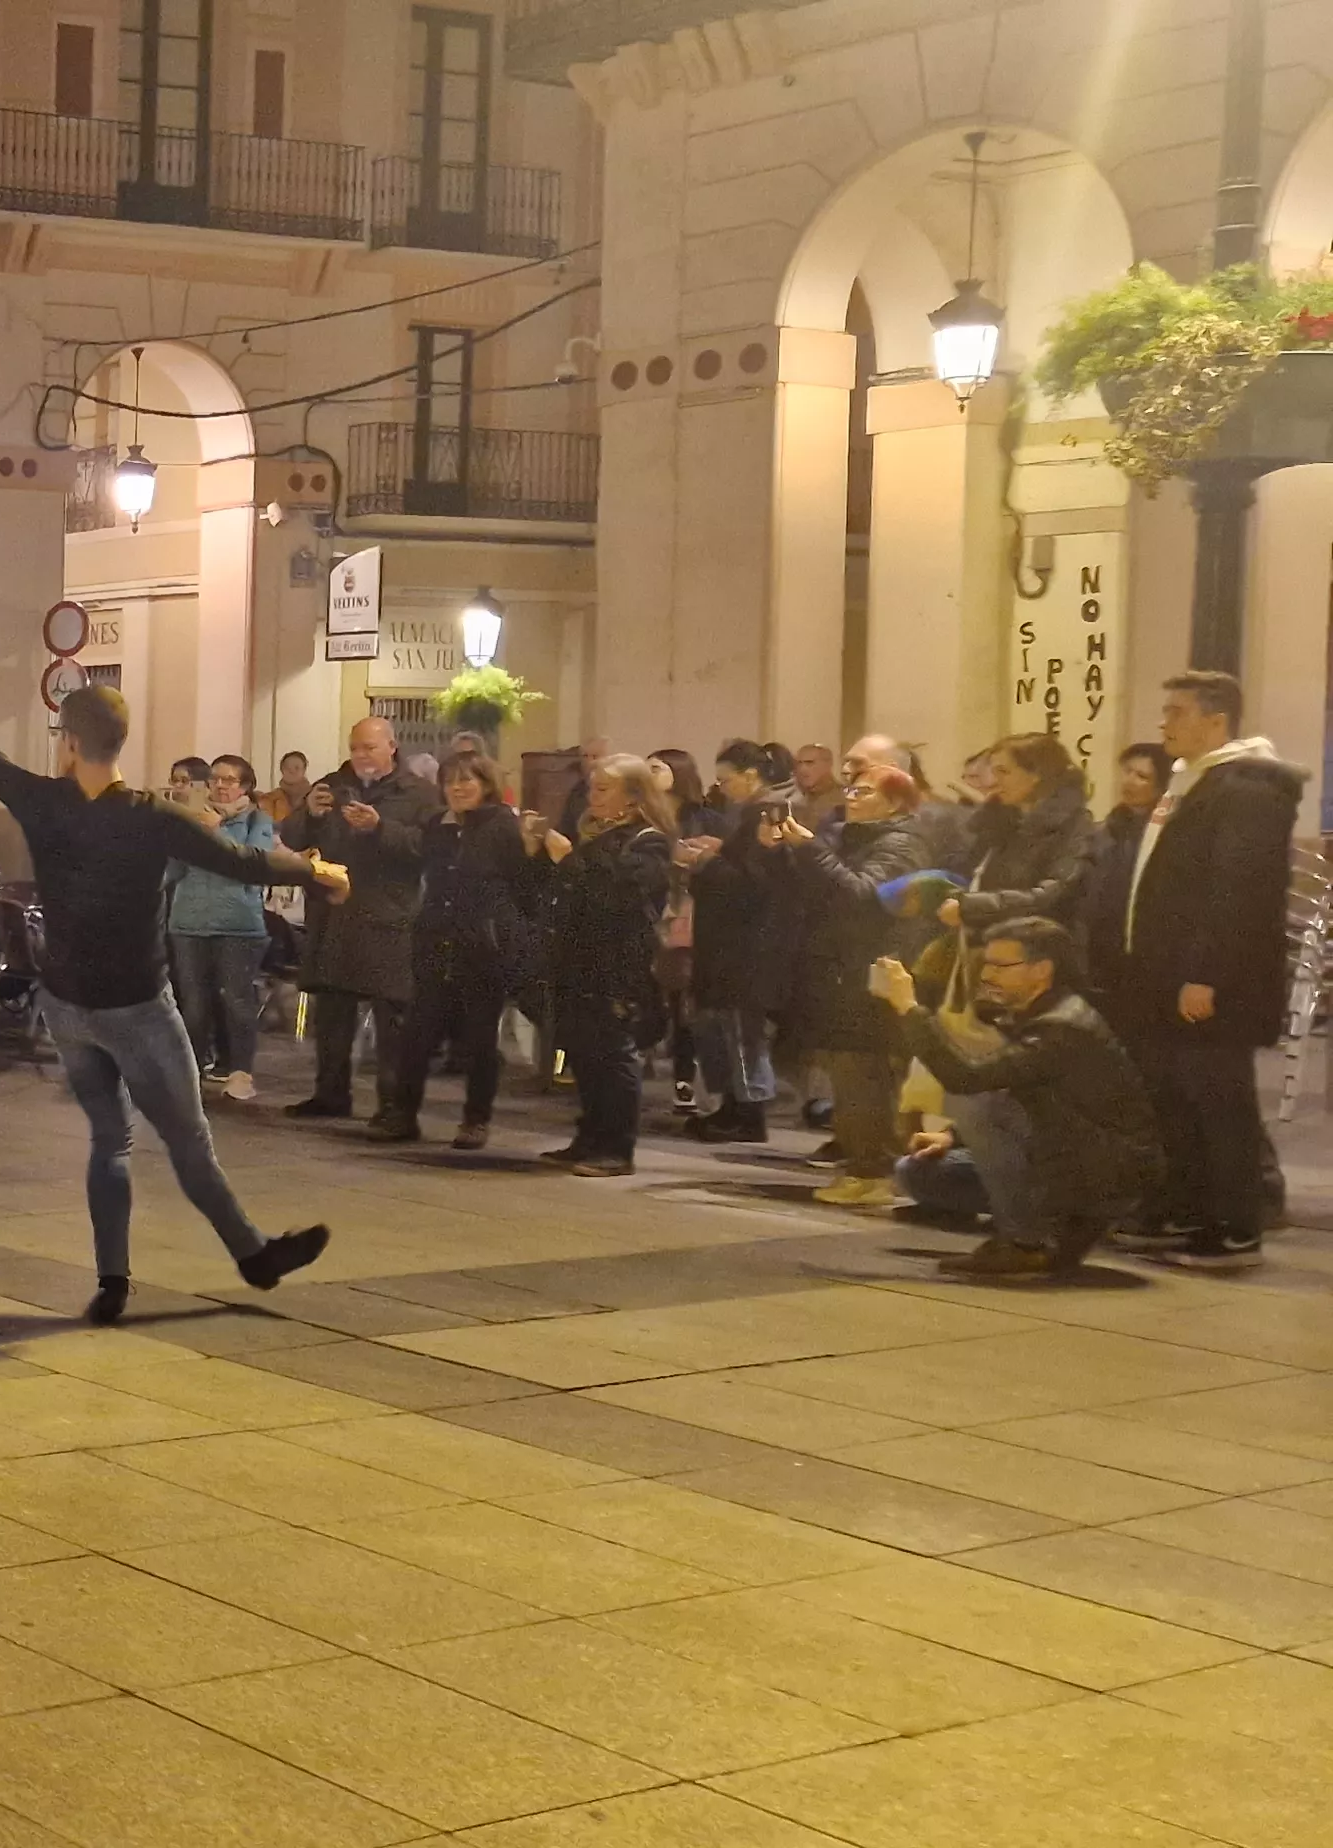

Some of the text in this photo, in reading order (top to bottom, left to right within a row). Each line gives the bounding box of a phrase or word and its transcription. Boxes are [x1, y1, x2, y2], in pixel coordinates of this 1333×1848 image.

[1080, 564, 1102, 623] NO
[90, 621, 119, 645] NES
[1016, 621, 1037, 705] SIN
[1084, 631, 1106, 722] HAY
